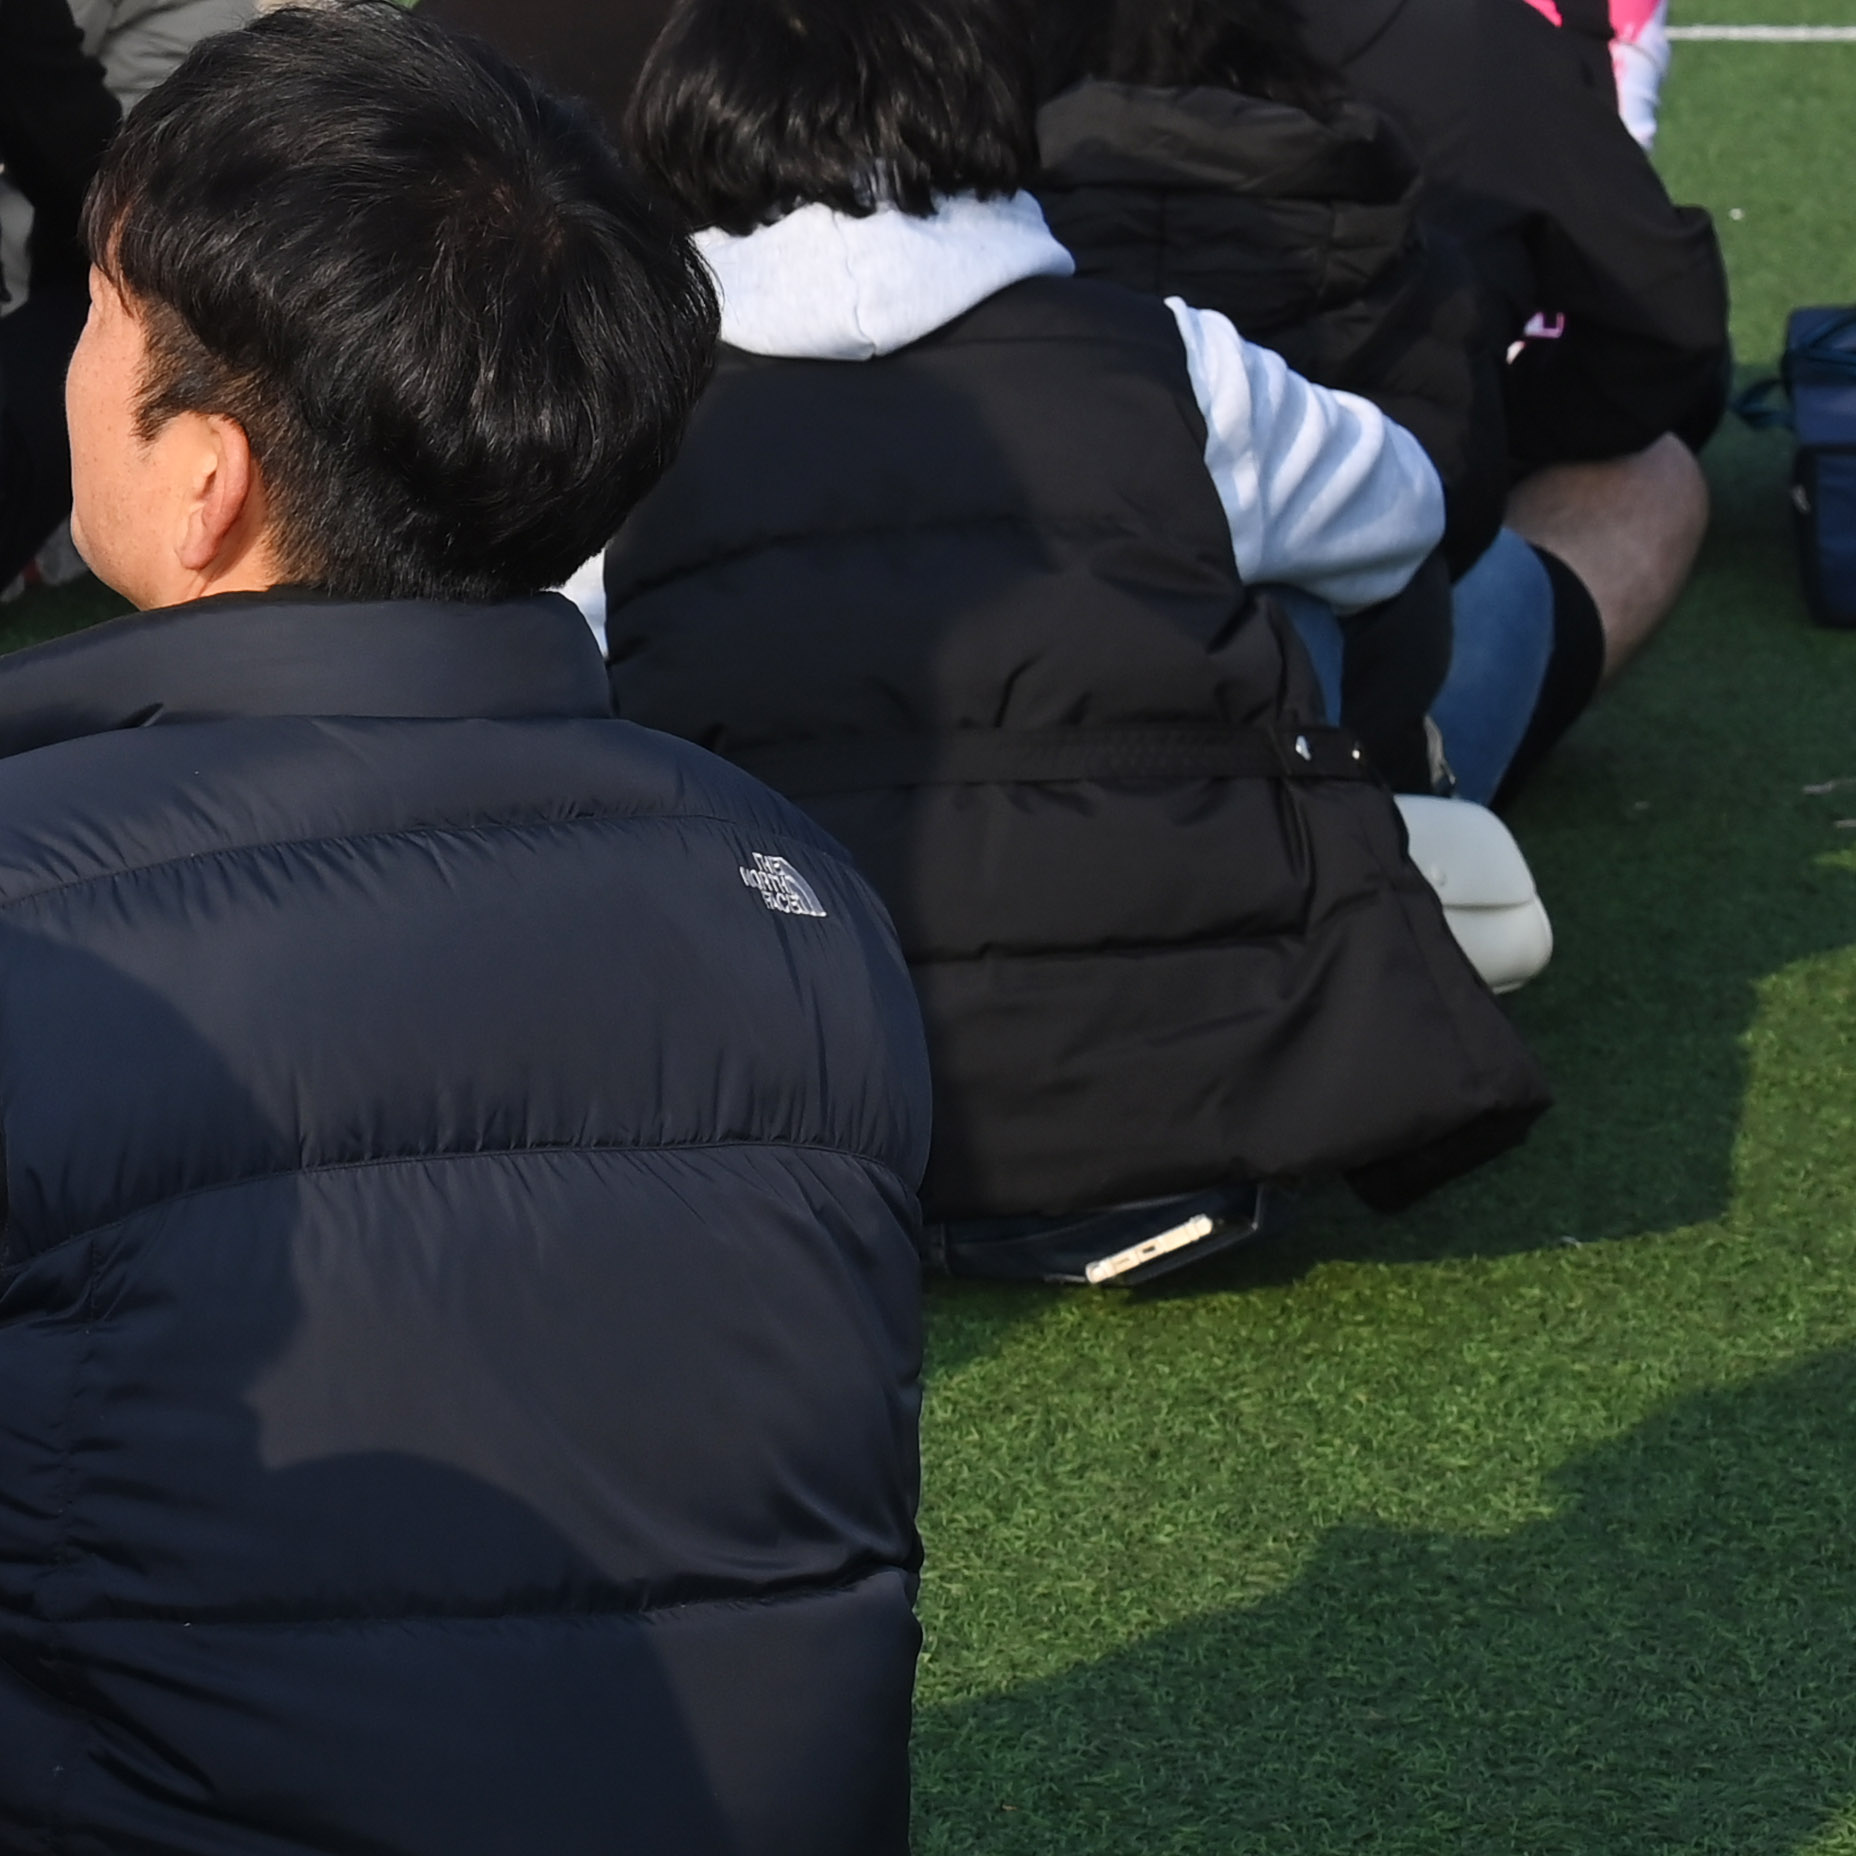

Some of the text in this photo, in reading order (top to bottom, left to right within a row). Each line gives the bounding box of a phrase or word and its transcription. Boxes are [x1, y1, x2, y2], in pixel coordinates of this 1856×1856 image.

[751, 851, 782, 875] THE
[739, 866, 791, 894] NORTH
[761, 890, 801, 914] FACE
